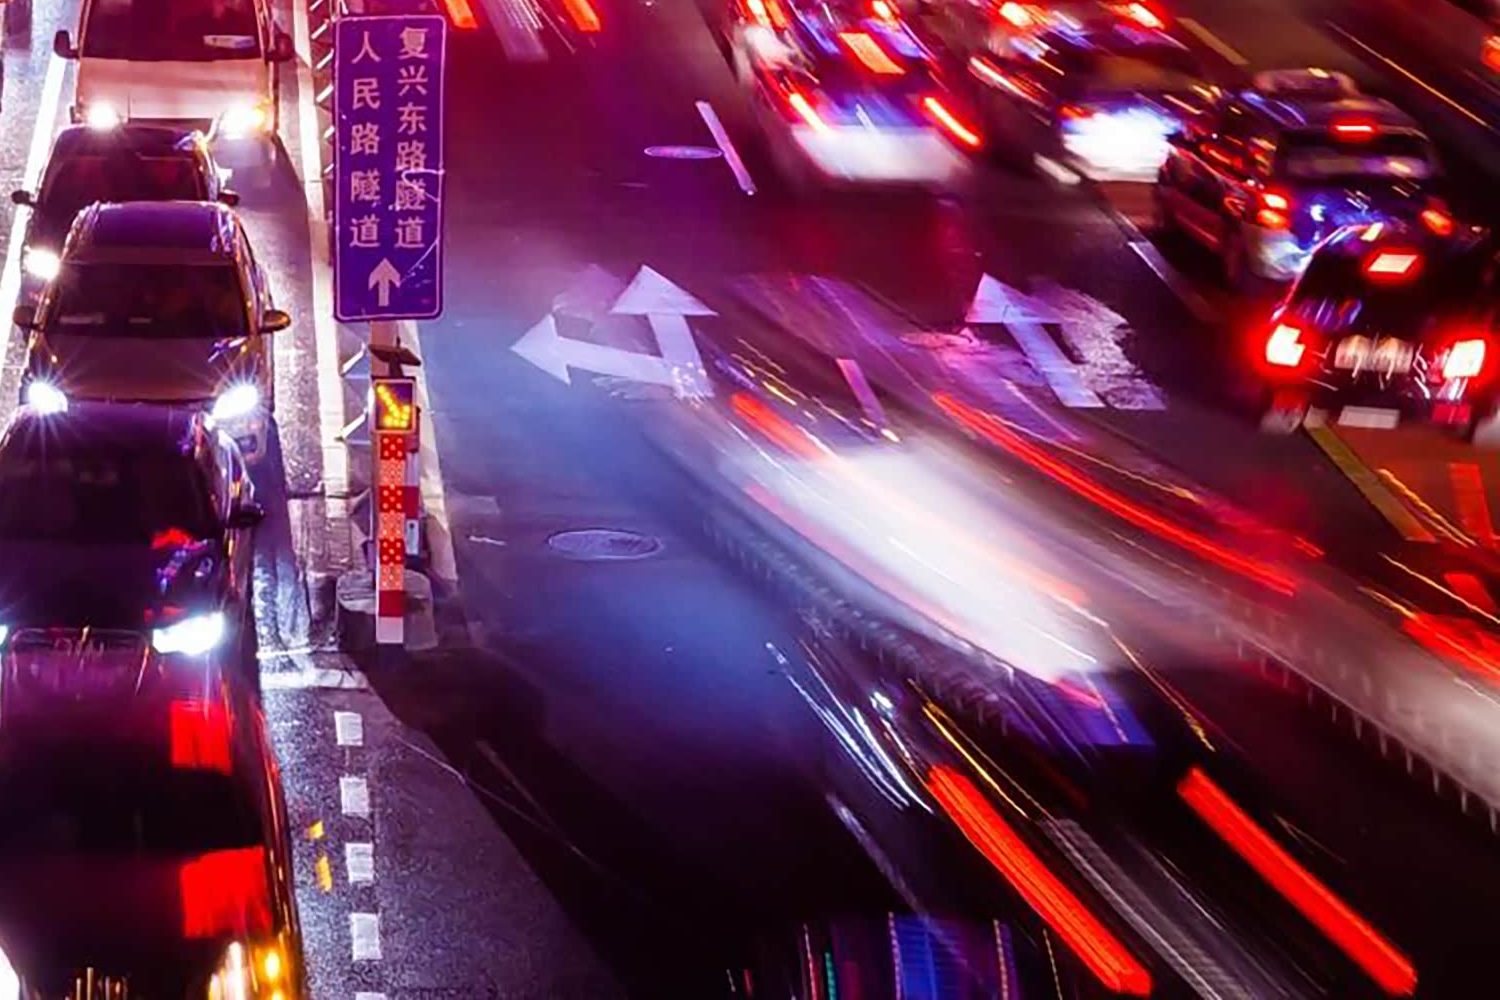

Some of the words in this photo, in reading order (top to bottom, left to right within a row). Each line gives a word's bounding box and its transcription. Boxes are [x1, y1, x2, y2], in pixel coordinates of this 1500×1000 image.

[349, 31, 381, 248] 人民路隧道
[394, 27, 428, 248] 复兴东路隧道
